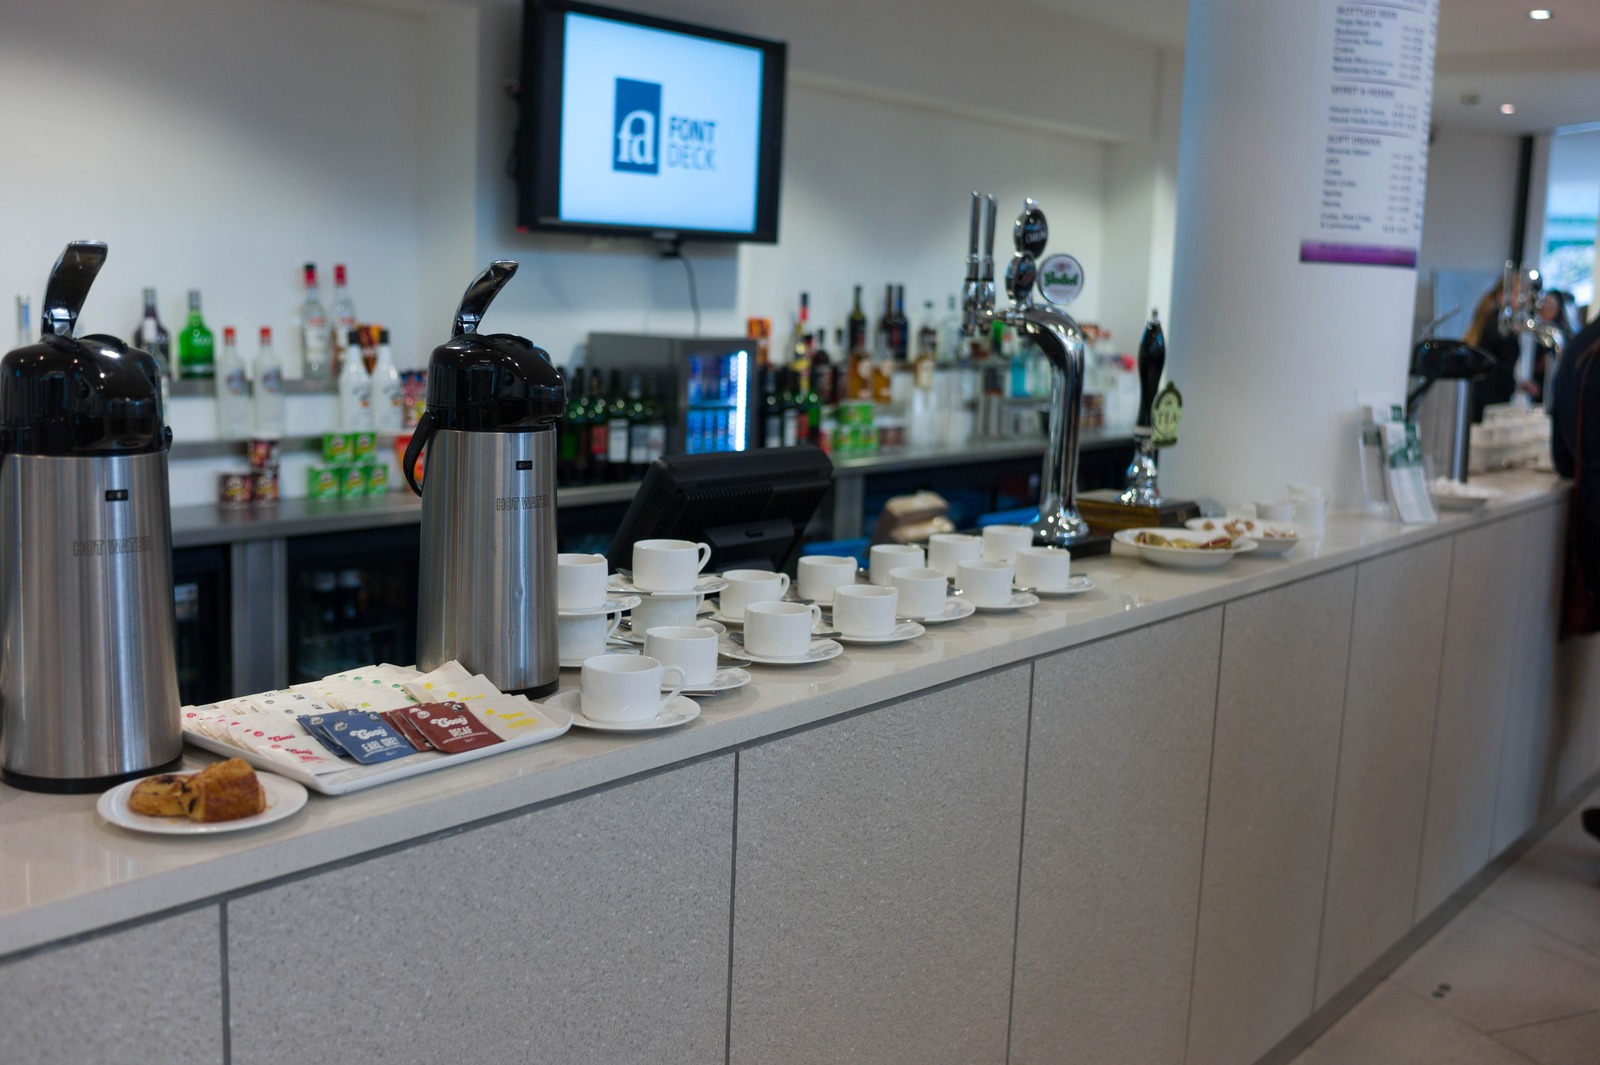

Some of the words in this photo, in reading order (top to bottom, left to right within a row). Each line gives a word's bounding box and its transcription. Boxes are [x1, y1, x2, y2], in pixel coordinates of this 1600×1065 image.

[669, 116, 717, 143] FONT
[667, 142, 717, 171] DECK
[496, 497, 519, 511] HOT
[521, 494, 551, 510] WATER
[73, 539, 105, 557] HOT
[108, 535, 151, 555] WATER
[448, 725, 473, 738] DECAF
[361, 740, 384, 752] EARL
